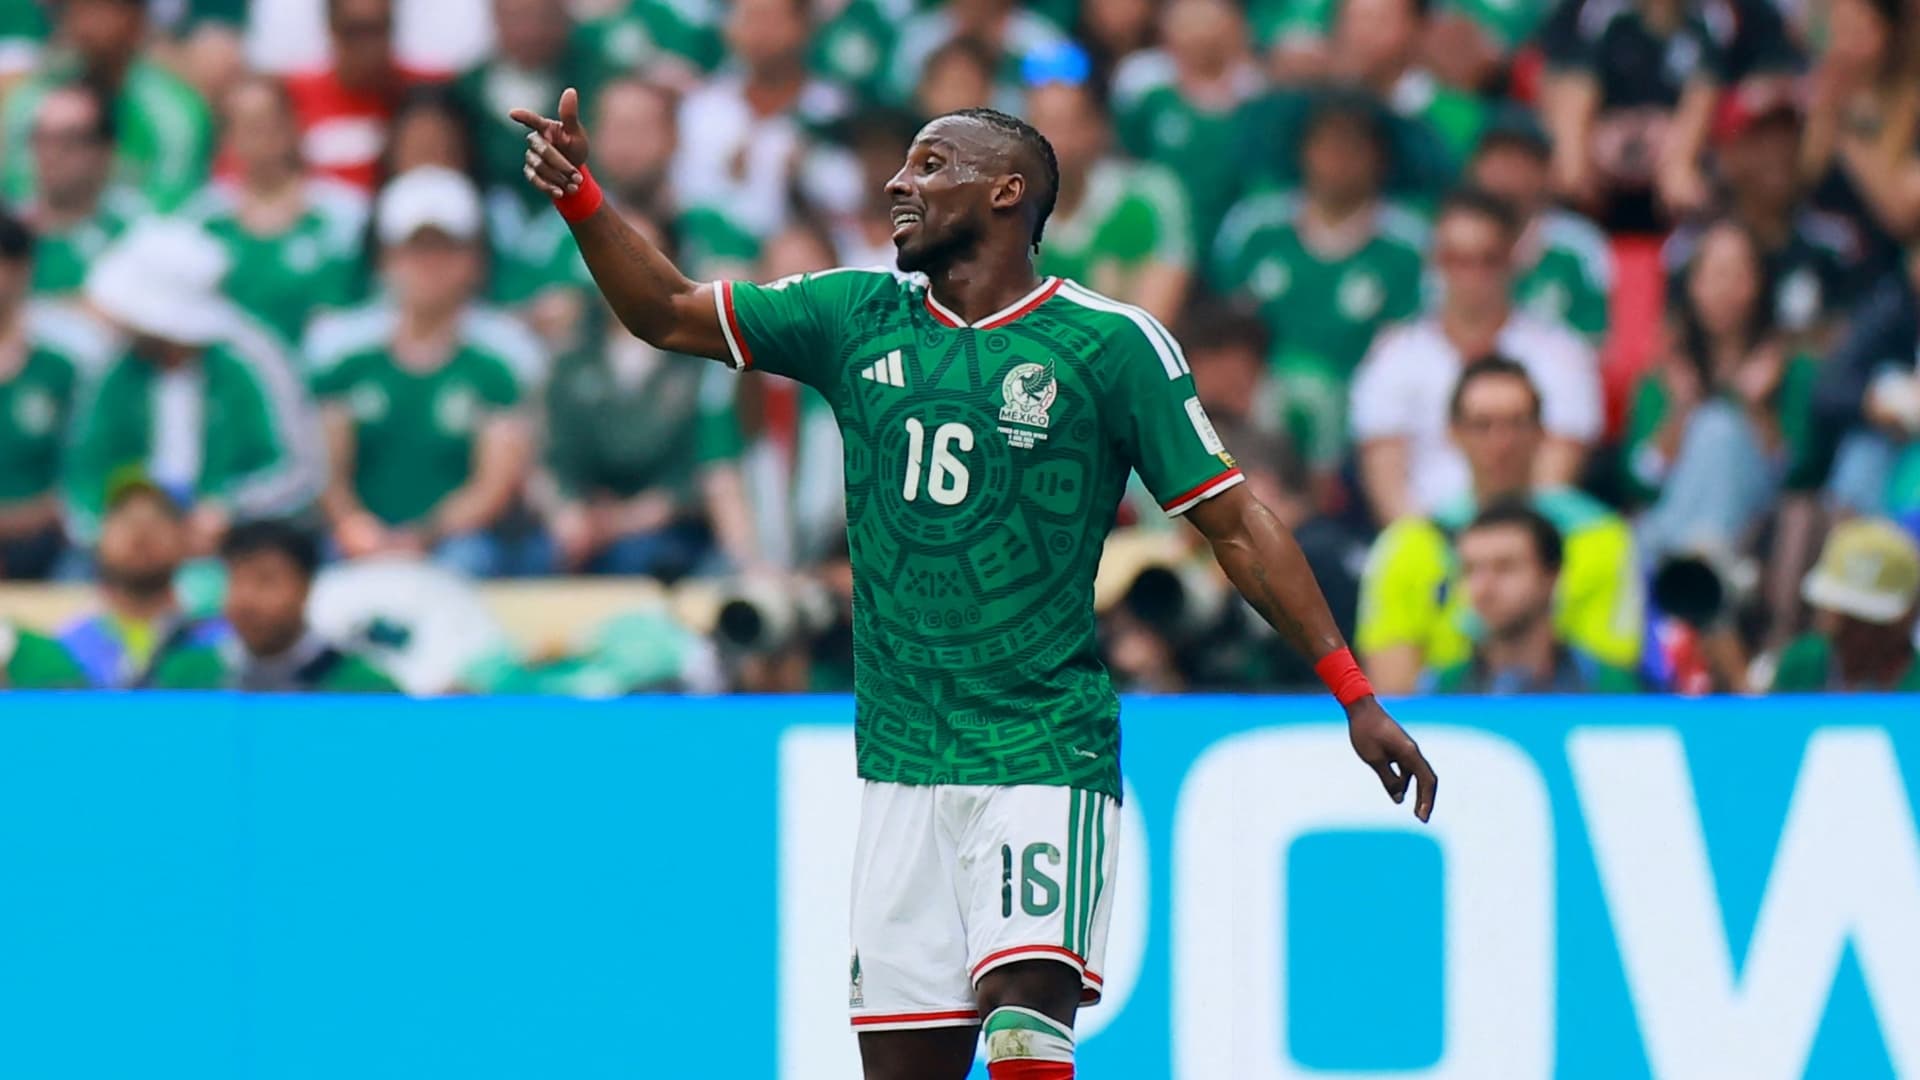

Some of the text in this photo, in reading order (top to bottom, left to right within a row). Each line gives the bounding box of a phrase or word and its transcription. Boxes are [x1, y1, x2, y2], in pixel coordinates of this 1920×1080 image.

[1000, 410, 1048, 426] MEXICO
[903, 417, 974, 505] 16
[1002, 842, 1061, 918] 16
